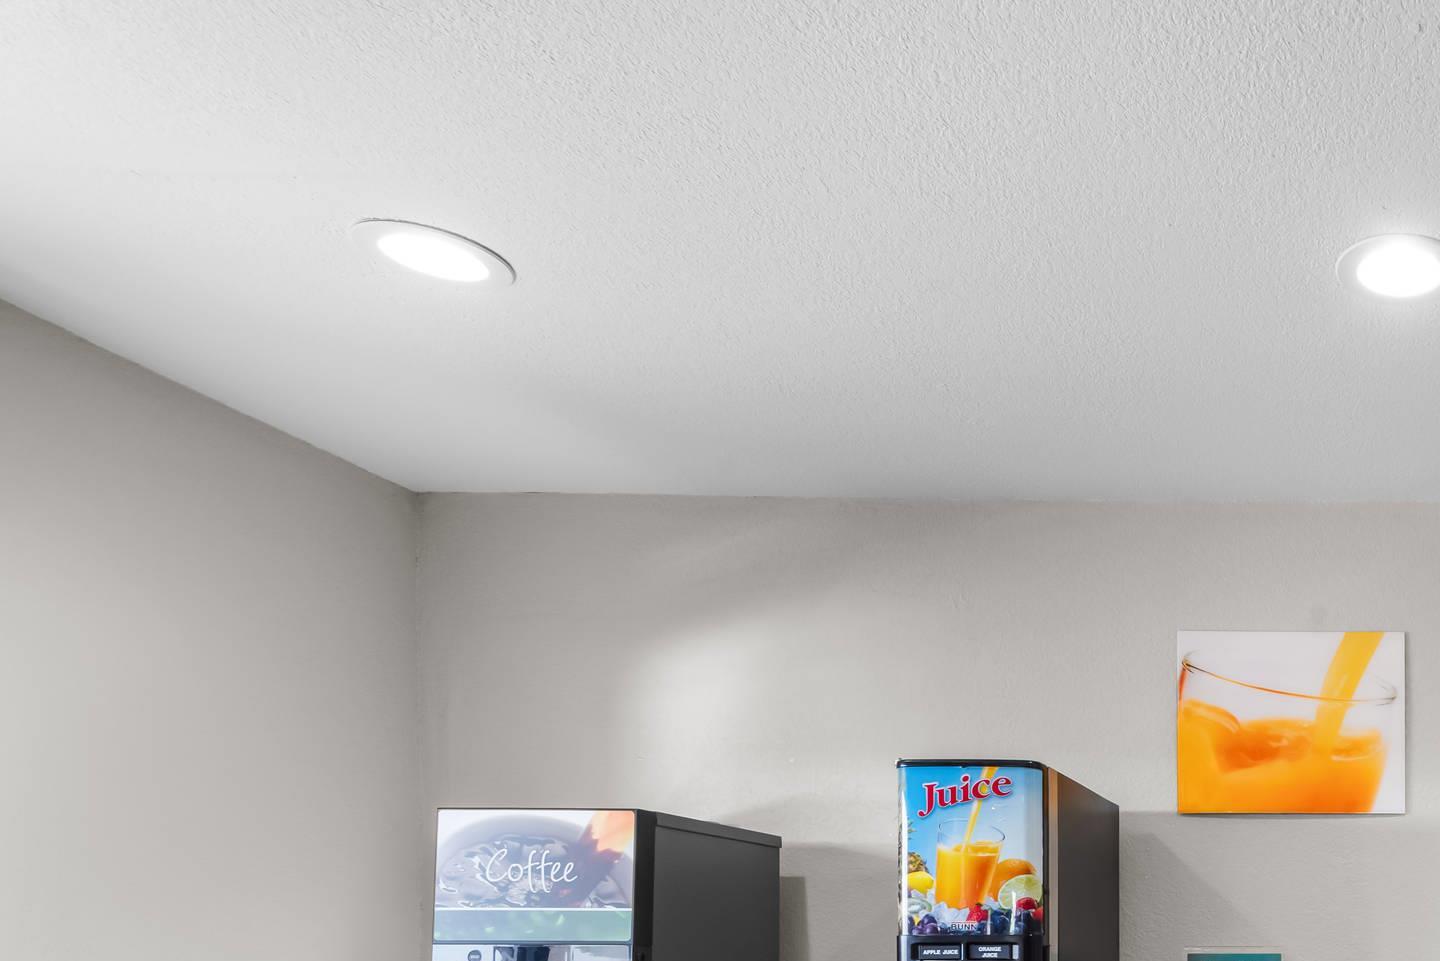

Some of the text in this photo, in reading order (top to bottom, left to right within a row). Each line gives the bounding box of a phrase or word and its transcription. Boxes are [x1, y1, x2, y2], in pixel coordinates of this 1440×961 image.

[917, 773, 1013, 817] Juice
[486, 848, 578, 893] Coffee
[951, 923, 977, 931] BUNN
